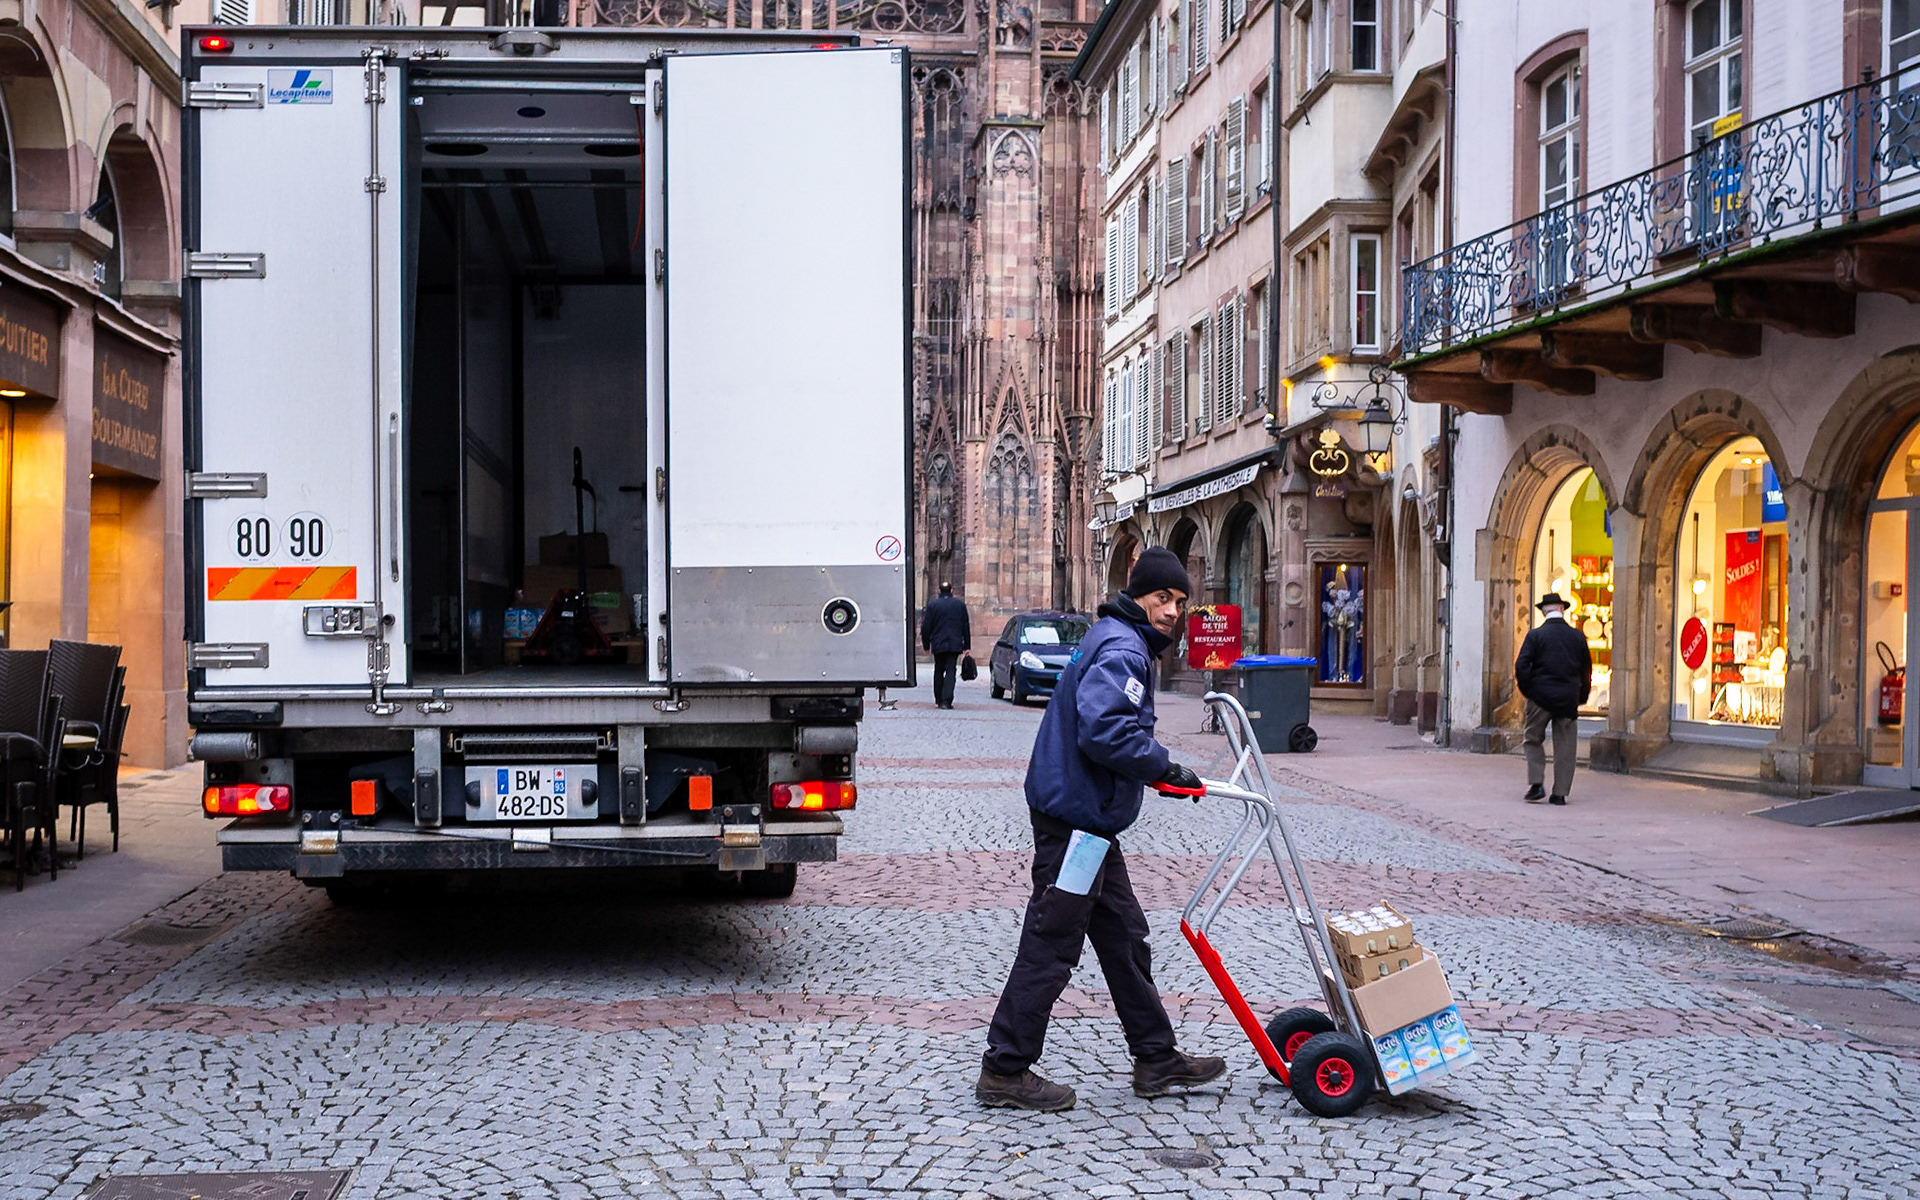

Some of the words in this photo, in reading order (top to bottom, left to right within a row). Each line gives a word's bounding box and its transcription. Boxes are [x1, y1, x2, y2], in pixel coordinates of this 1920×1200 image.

[270, 88, 331, 99] Lecapitaine
[92, 406, 157, 460] GOURMANDE
[1203, 483, 1212, 497] LA
[237, 518, 270, 557] 80
[290, 518, 323, 557] 90
[1726, 561, 1755, 584] SOLDES
[1683, 631, 1702, 662] SOLDES
[555, 782, 564, 792] 93
[498, 796, 564, 816] 482-DS
